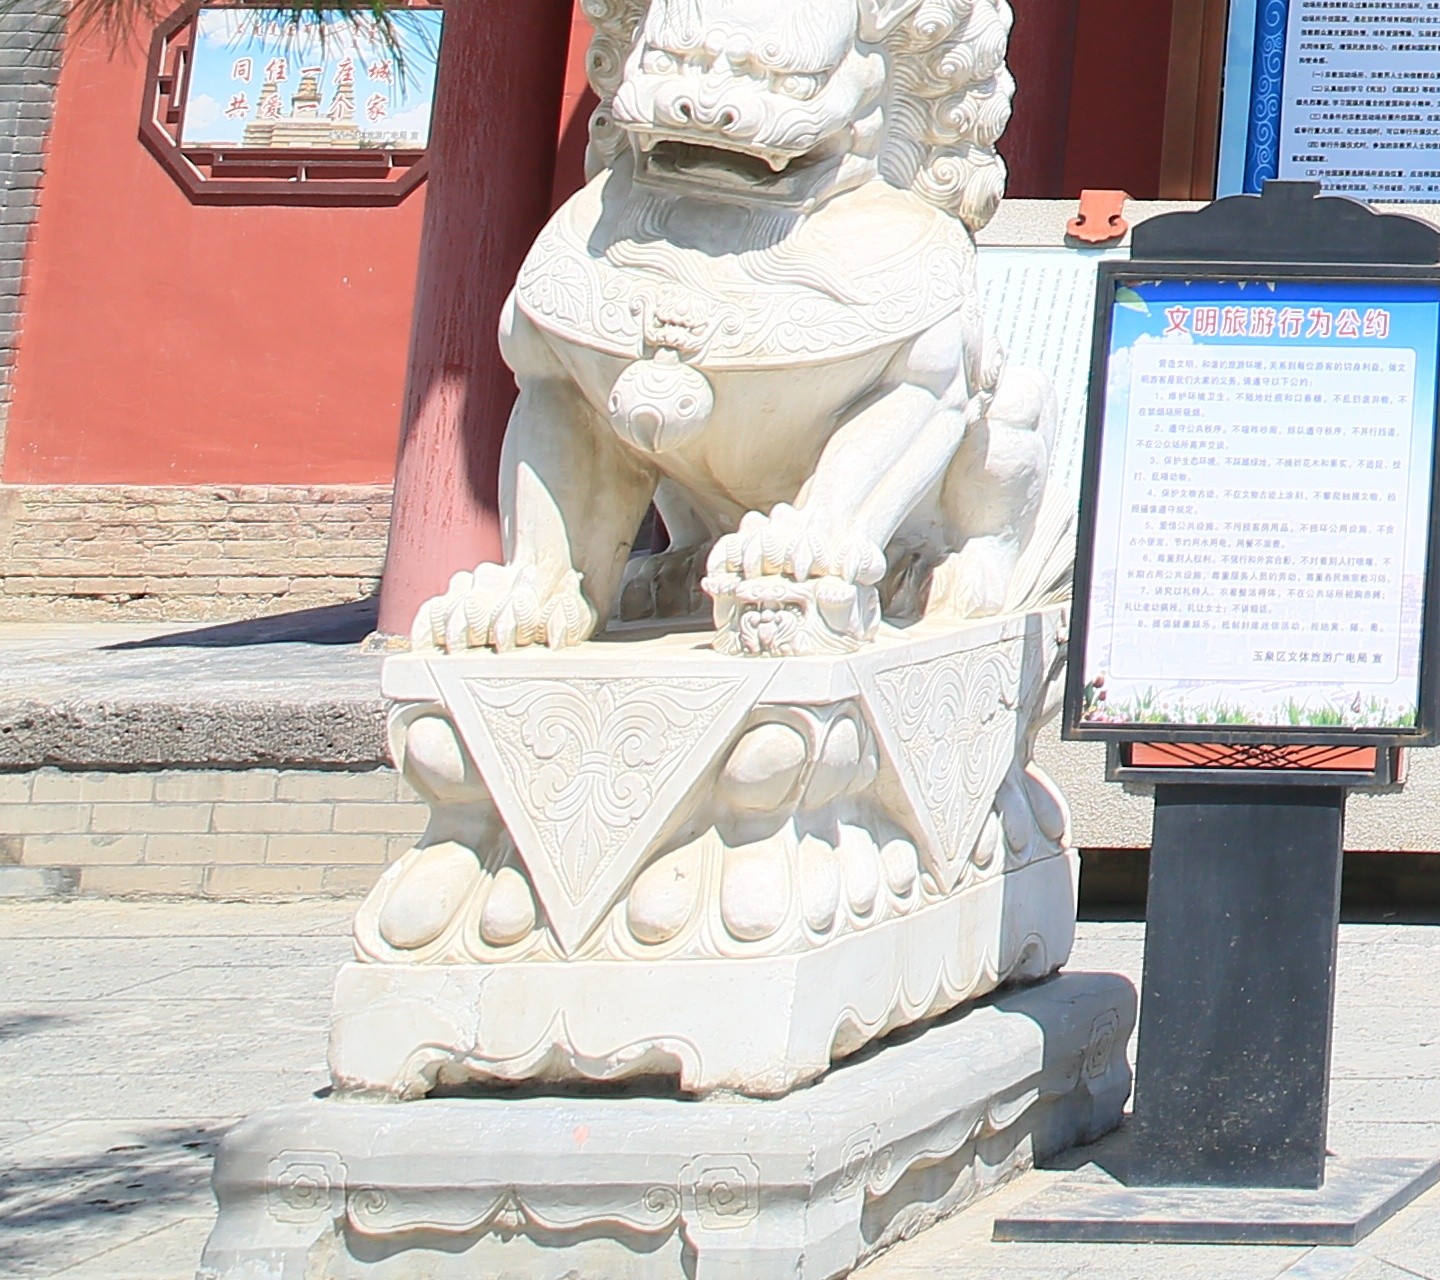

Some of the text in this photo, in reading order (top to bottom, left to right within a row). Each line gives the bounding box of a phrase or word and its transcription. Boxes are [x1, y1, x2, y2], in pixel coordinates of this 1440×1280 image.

[231, 57, 394, 85] 同住一座城
[224, 92, 390, 123] 共爱一个家
[1162, 306, 1391, 340] 文明旅游行为公约
[1252, 650, 1369, 664] 玉泉区文体旅游广电局
